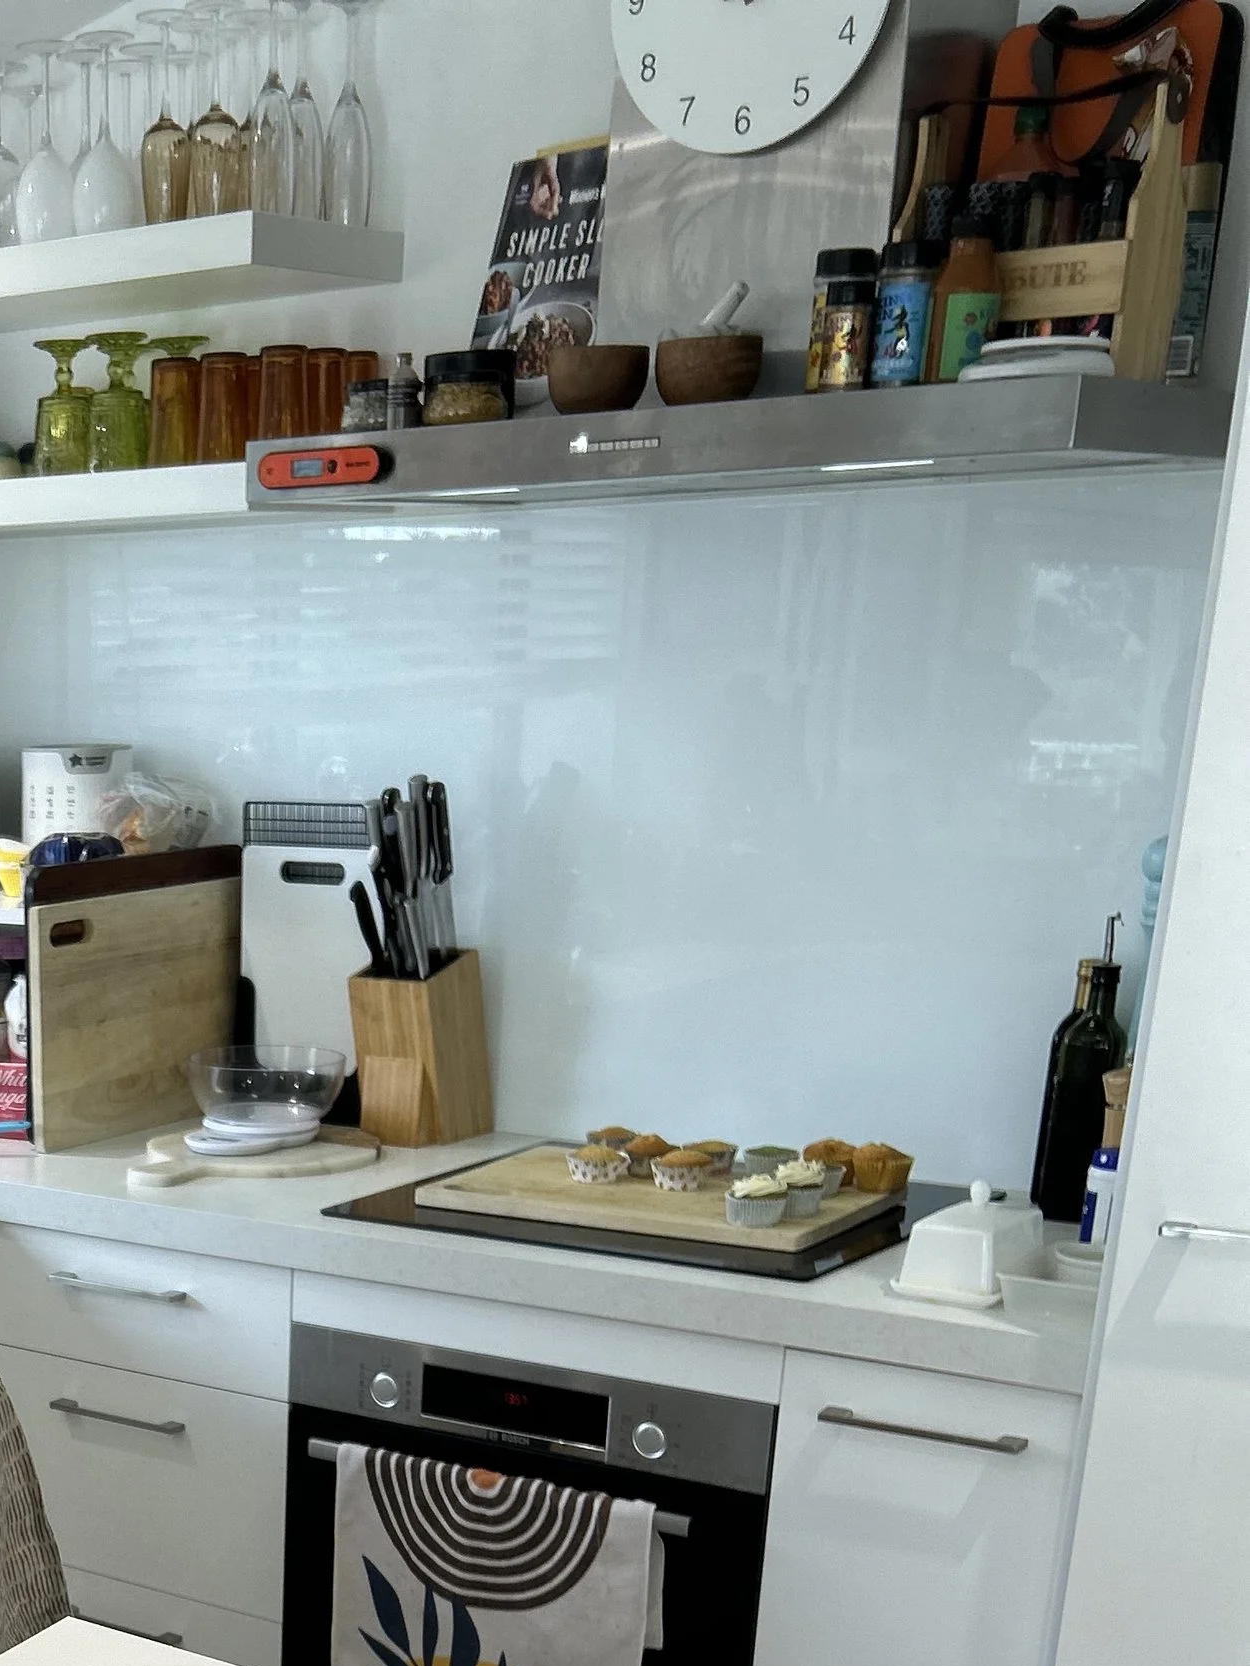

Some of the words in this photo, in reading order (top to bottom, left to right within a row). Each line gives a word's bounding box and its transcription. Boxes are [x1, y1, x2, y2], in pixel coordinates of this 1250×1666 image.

[838, 15, 856, 45] 4
[640, 52, 656, 82] 8
[792, 76, 810, 107] 5
[679, 96, 696, 126] 7
[734, 105, 751, 135] 6
[506, 222, 572, 258] SIMPLE
[522, 253, 591, 289] COOKER
